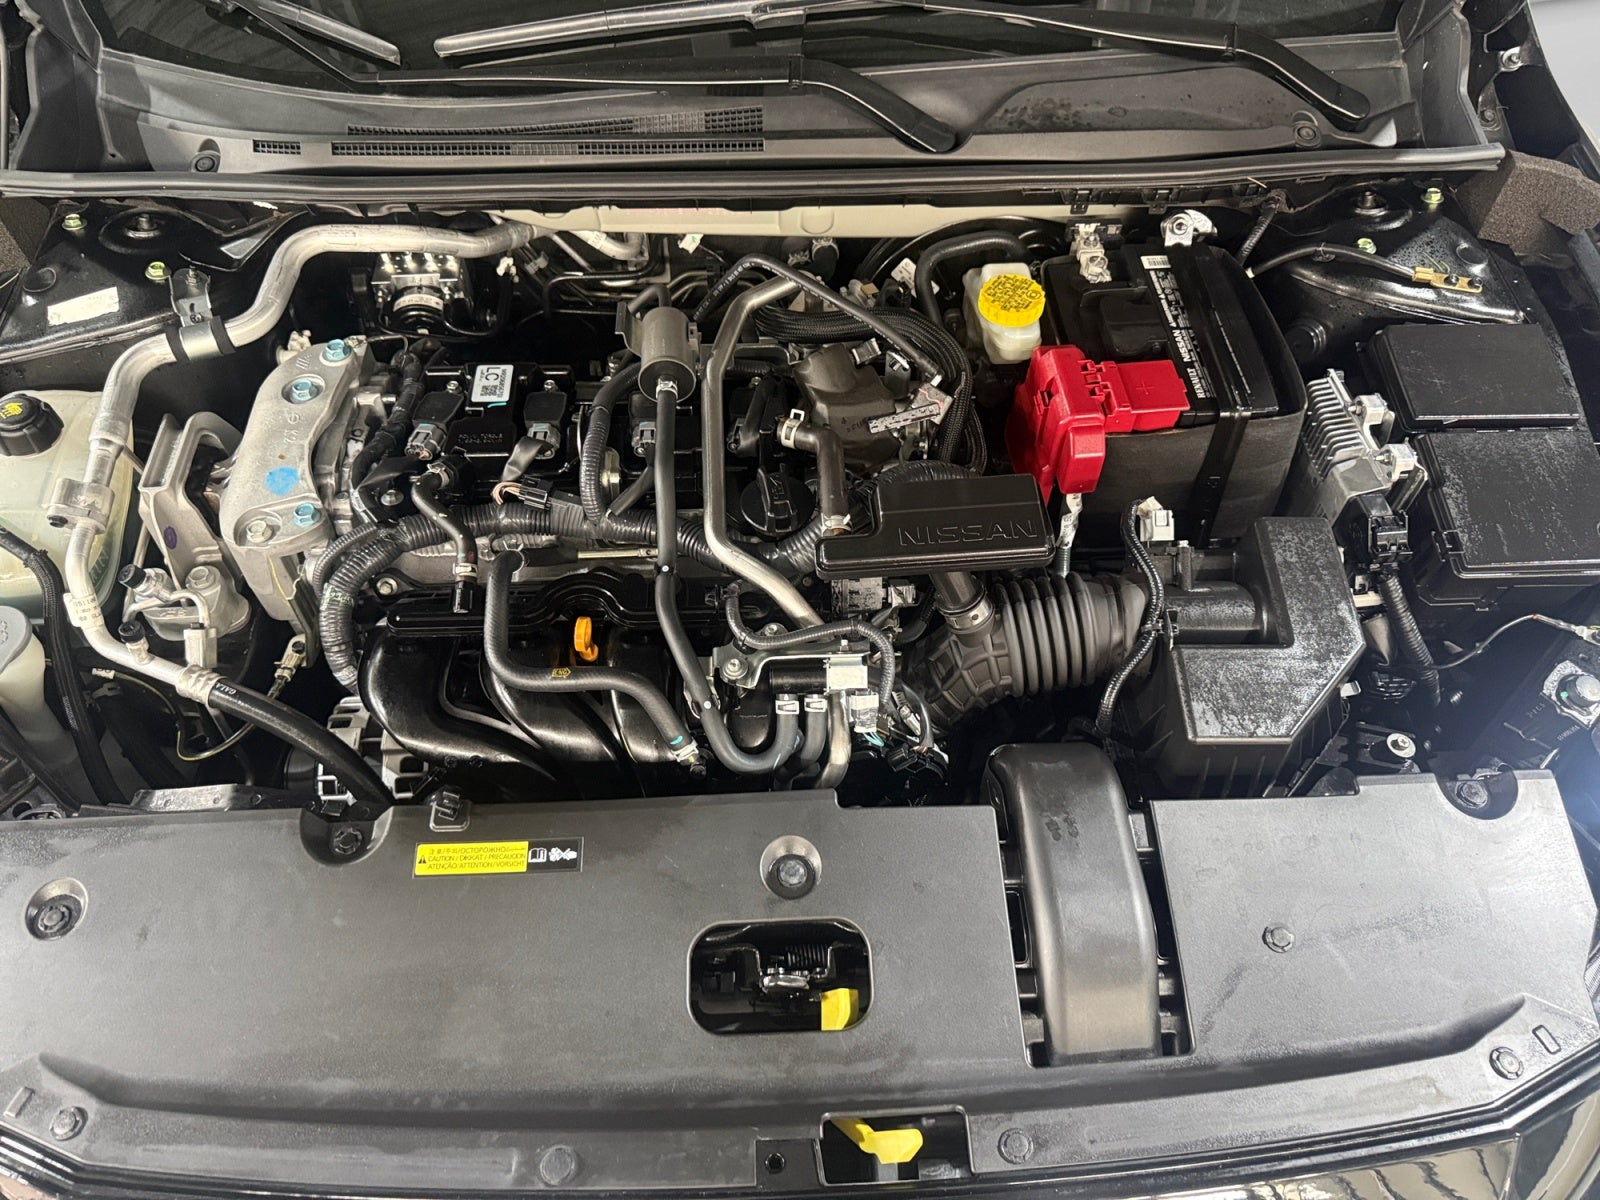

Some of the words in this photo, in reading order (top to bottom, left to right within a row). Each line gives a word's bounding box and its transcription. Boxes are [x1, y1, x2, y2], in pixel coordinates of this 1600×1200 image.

[1173, 330, 1191, 362] NISSAN
[485, 367, 501, 381] LC
[1187, 368, 1206, 398] RENAULT
[898, 520, 1038, 546] NISSAN
